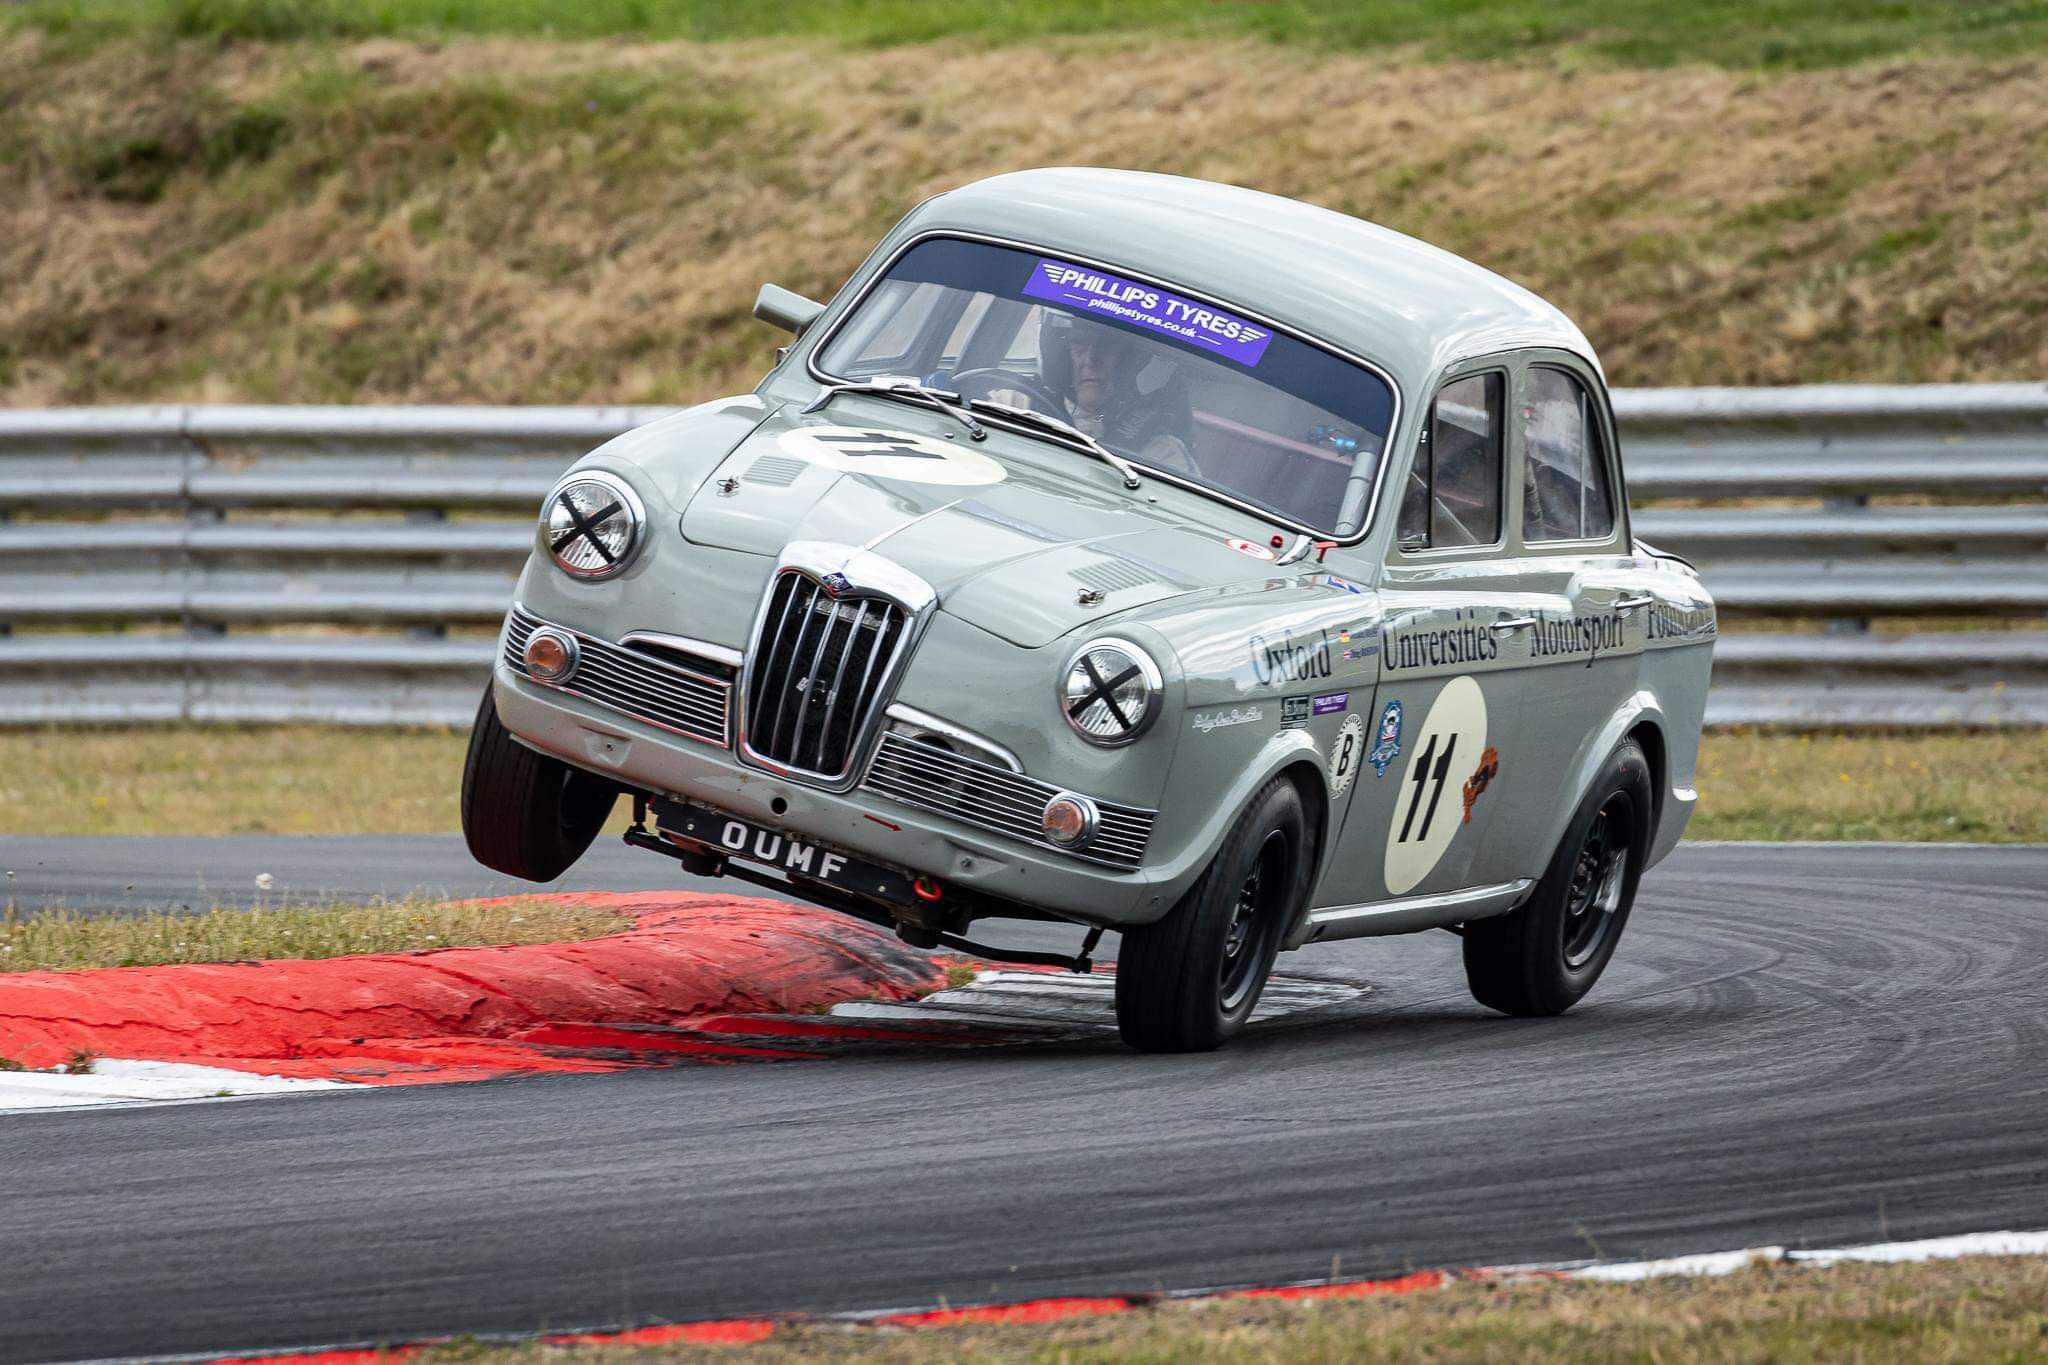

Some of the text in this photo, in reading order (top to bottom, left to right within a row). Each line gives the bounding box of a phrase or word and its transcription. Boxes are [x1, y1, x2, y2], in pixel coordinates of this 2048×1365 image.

[1060, 269, 1241, 340] PHILLIPS TYRES
[1088, 298, 1196, 338] phillipstyres.co.uk
[812, 432, 947, 460] 11
[1249, 629, 1332, 686] Oxford
[1382, 608, 1498, 671] Universities
[1528, 609, 1624, 668] Motorsport
[1336, 733, 1354, 776] B
[1397, 732, 1459, 843] 11
[721, 820, 849, 879] OUMF
